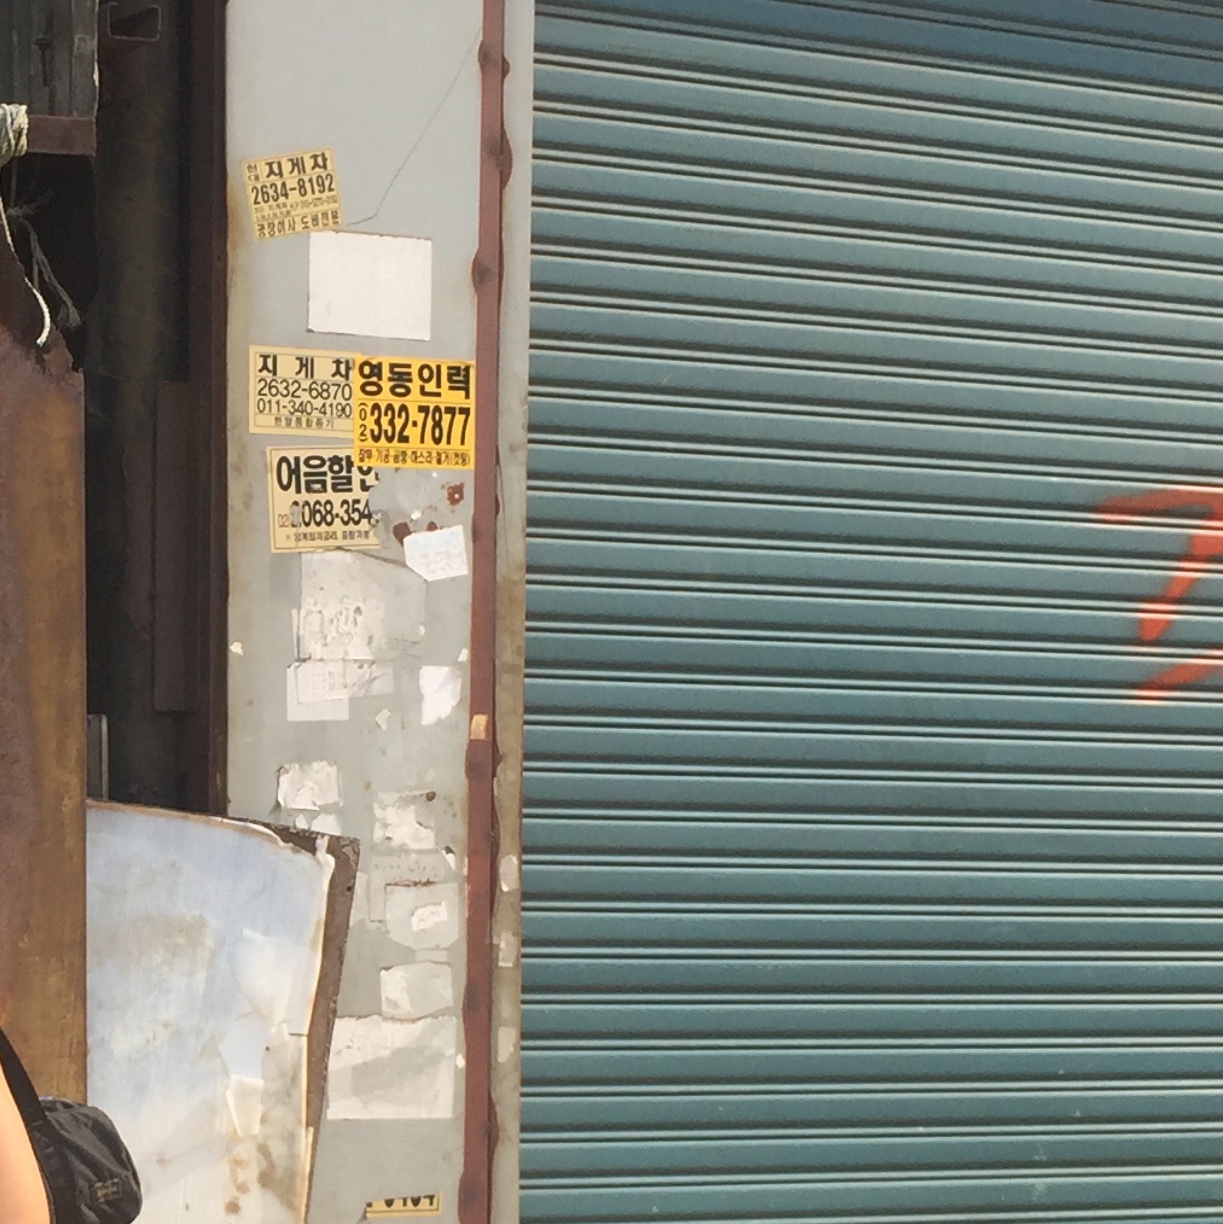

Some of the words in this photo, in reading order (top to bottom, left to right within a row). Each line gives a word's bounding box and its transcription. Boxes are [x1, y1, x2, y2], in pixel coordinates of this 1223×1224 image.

[251, 173, 335, 205] 2634-8192
[257, 378, 353, 401] 2632-6870
[358, 361, 471, 400] 영동인력
